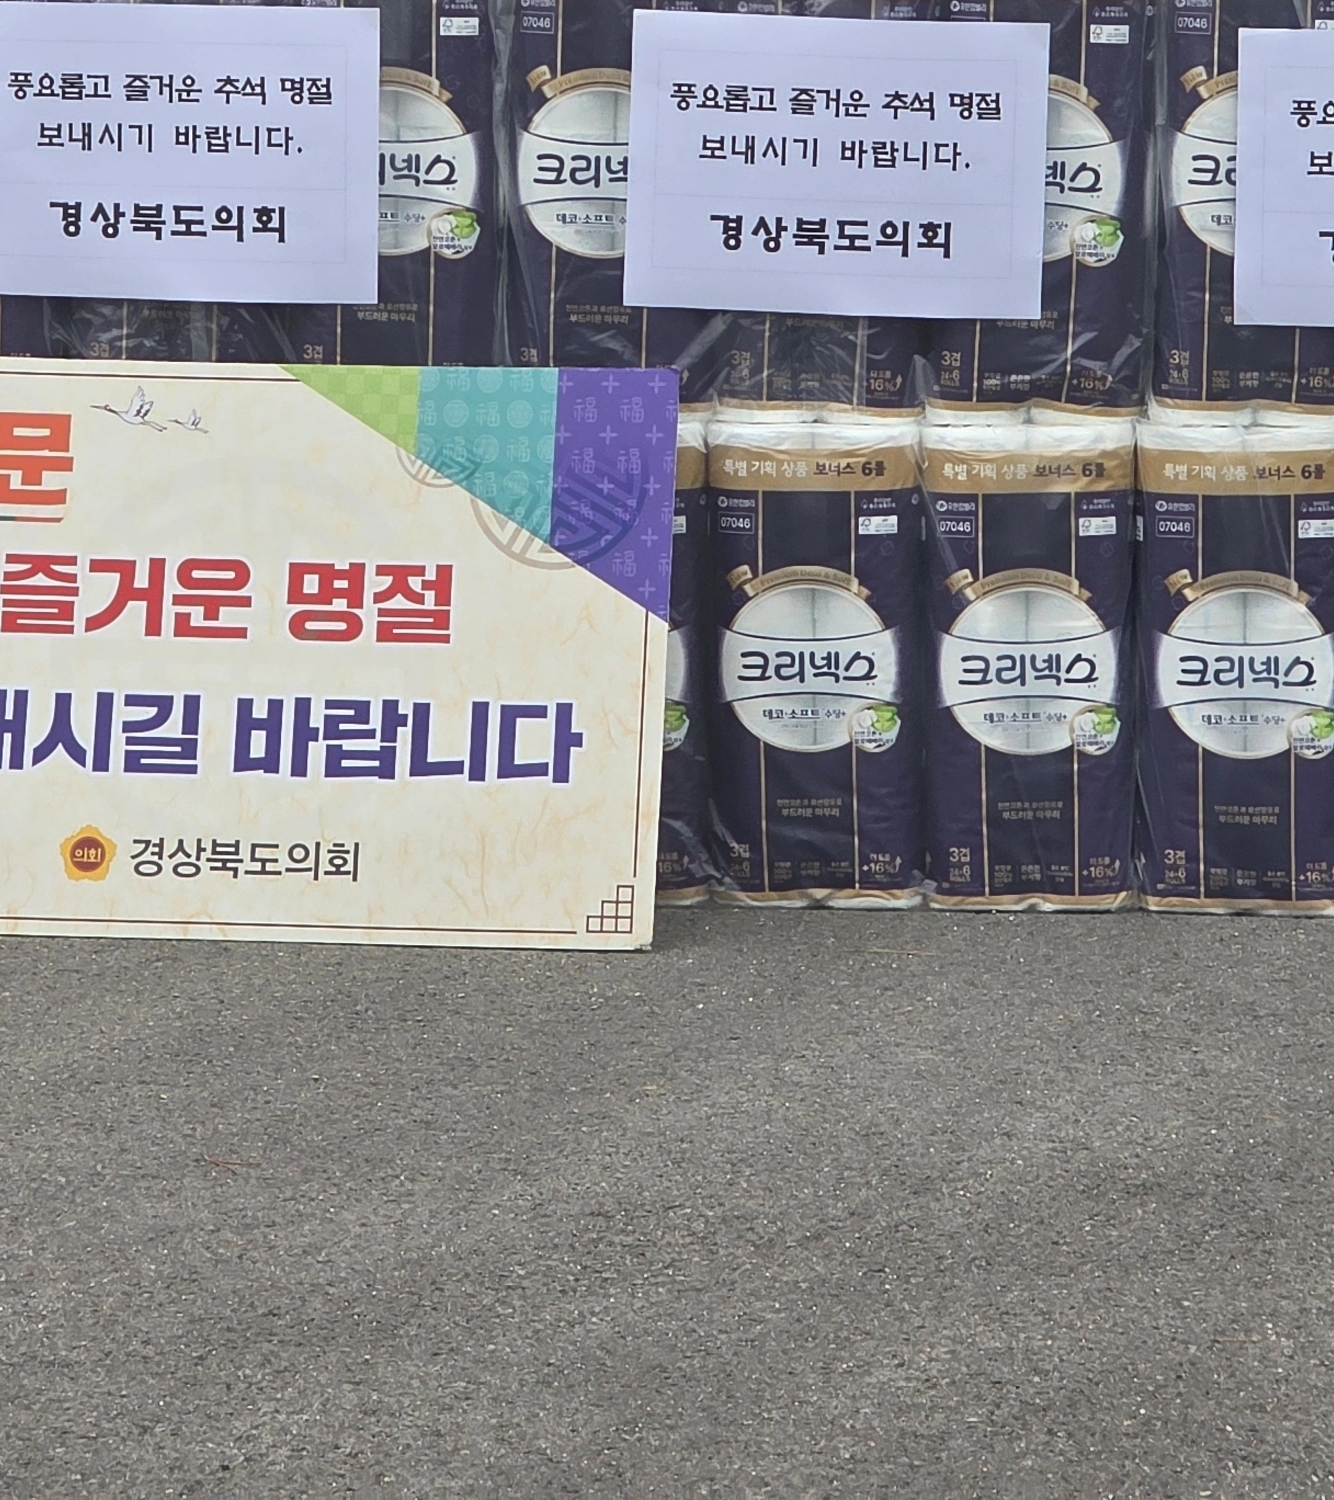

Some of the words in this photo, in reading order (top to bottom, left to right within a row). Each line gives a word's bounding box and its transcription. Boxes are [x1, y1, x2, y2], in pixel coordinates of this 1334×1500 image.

[7, 71, 112, 101] 풍요롭고
[122, 73, 202, 103] 즐거운
[213, 76, 267, 105] 추석
[279, 76, 333, 106] 명절
[669, 82, 778, 113] 풍요롭고
[788, 87, 870, 118] 즐거운
[880, 90, 936, 121] 추석
[948, 91, 1002, 121] 명절
[36, 122, 154, 152] 보내시기
[174, 125, 304, 155] 바랍니다.
[698, 134, 819, 167] 보내시기
[840, 139, 971, 171] 바랍니다.
[533, 153, 628, 188] 크리넥
[49, 201, 287, 243] 경상북도의회
[709, 214, 953, 259] 경상북도의회
[813, 459, 856, 477] 보너스
[861, 459, 887, 477] 6롤
[1033, 462, 1075, 479] 보너스
[1081, 461, 1107, 479] 6롤
[720, 516, 752, 529] 07046
[0, 553, 254, 640] 즐거운
[285, 560, 454, 646] 명절
[737, 650, 878, 685] 크리넥스
[958, 653, 1099, 688] 크리넥스
[1176, 654, 1318, 690] 크리넥스
[232, 697, 584, 784] 바랍니다
[130, 836, 360, 883] 경상북도의회
